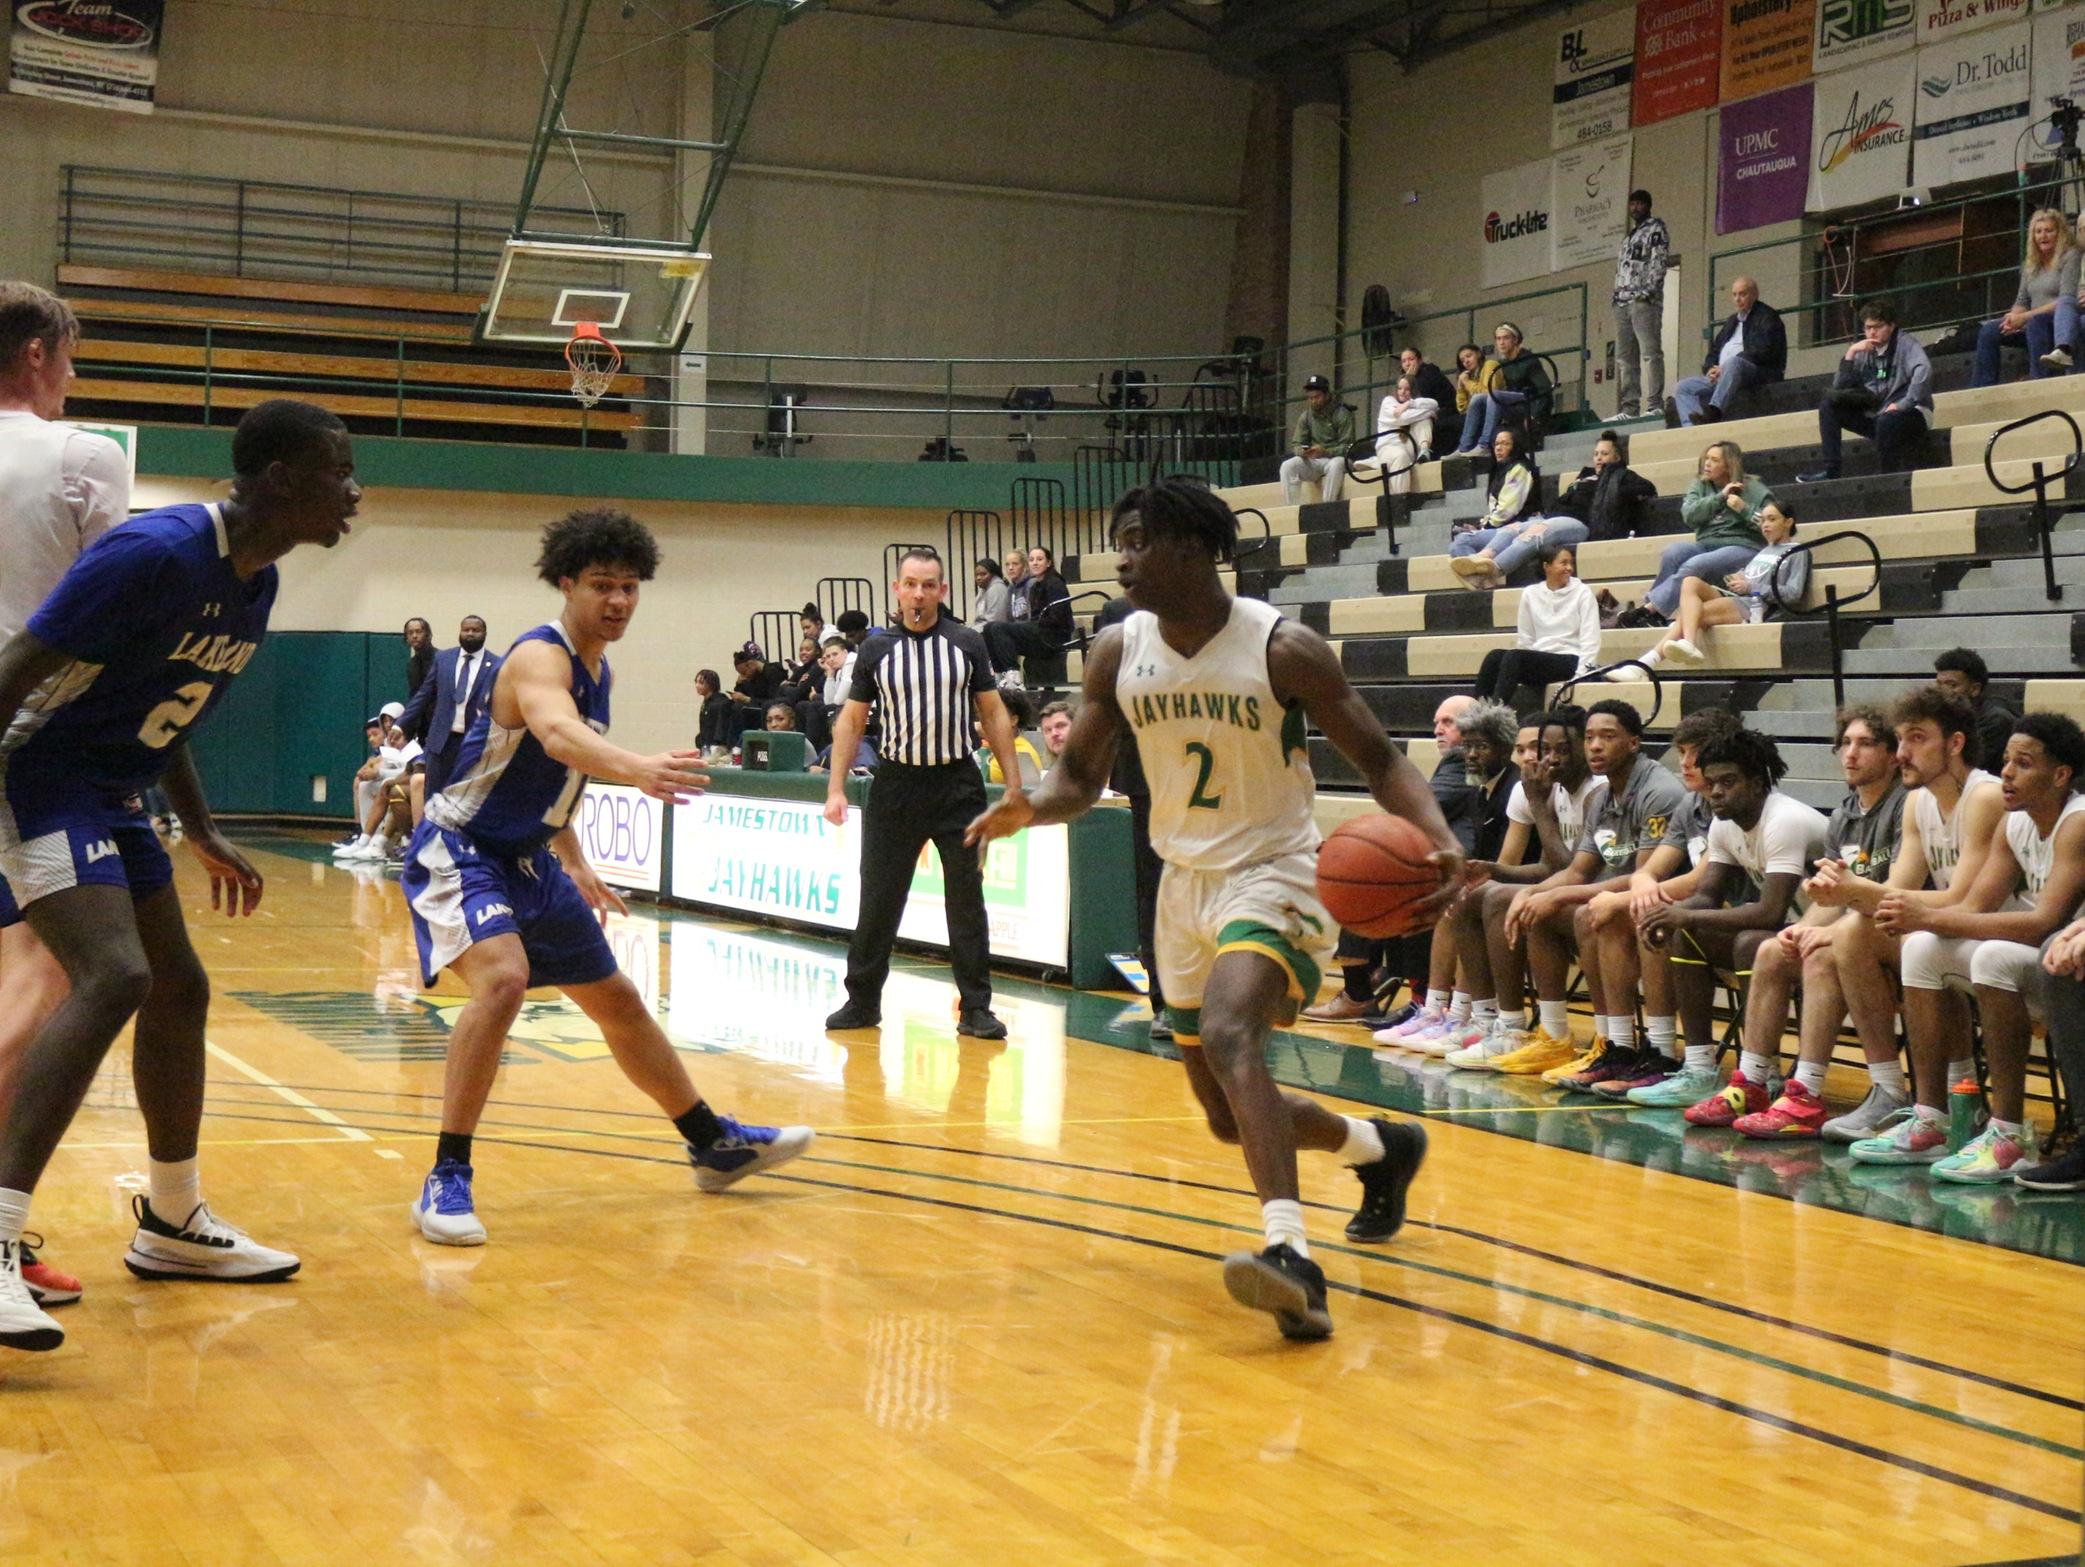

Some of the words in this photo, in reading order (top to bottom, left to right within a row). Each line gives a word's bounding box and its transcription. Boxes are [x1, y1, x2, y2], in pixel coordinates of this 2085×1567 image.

[58, 0, 113, 15] Team
[1643, 0, 1714, 34] Community
[1928, 8, 1963, 29] Pizza
[1966, 2, 1980, 18] &
[1665, 21, 1697, 50] Bank
[1957, 59, 1981, 86] Dr.
[1983, 44, 2027, 78] Todd
[1736, 128, 1778, 156] UPMC
[1854, 129, 1905, 154] INSURANCE
[1736, 156, 1797, 180] CHAUTAUQUA
[137, 680, 214, 749] 2
[1132, 692, 1261, 731] JAYHAWKS
[1185, 741, 1221, 809] 2
[708, 856, 841, 914] JAYHAWKS
